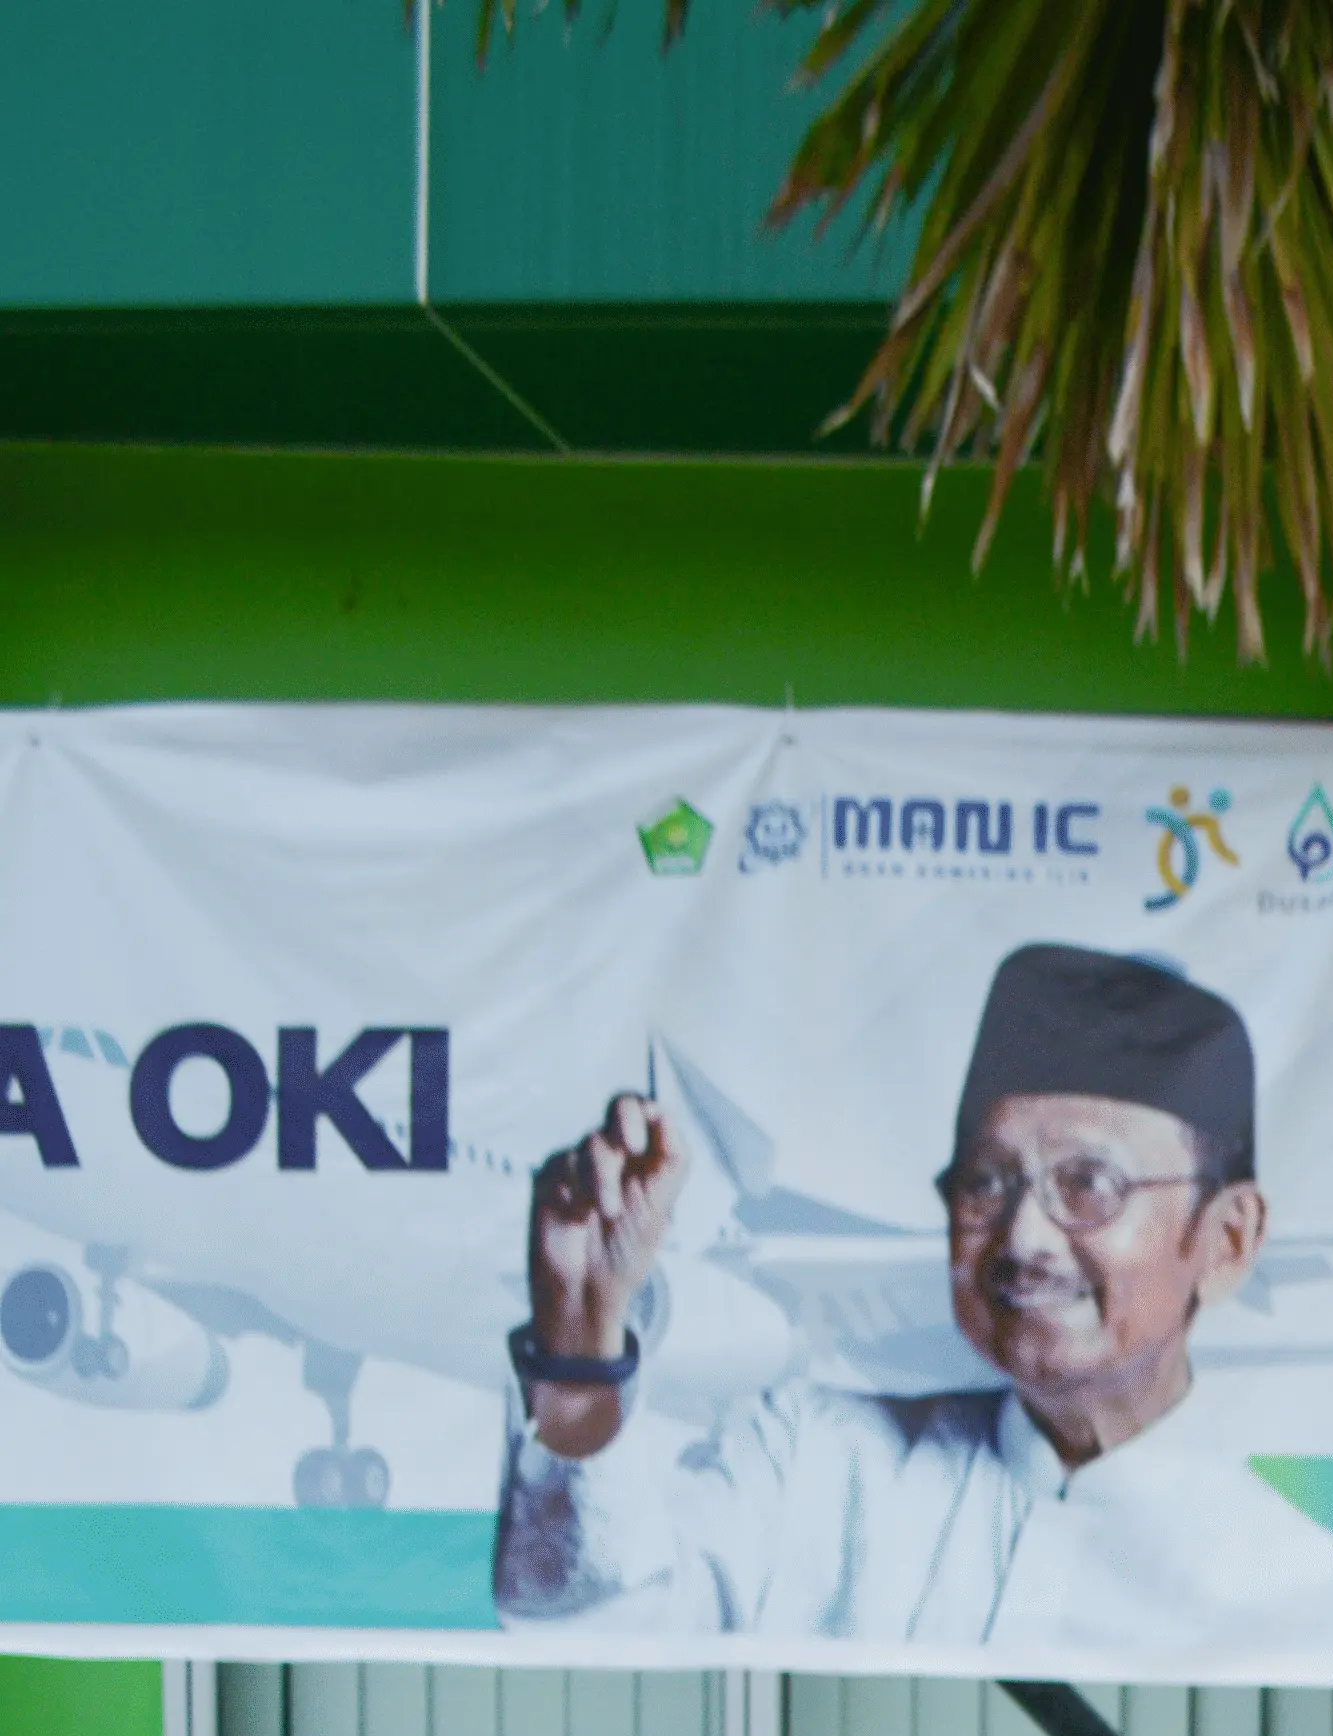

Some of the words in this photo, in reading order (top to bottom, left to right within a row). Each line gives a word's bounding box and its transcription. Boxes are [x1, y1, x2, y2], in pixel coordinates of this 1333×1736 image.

[833, 797, 1011, 855] MAN
[1033, 801, 1099, 855] IC
[129, 1023, 450, 1172] OKI
